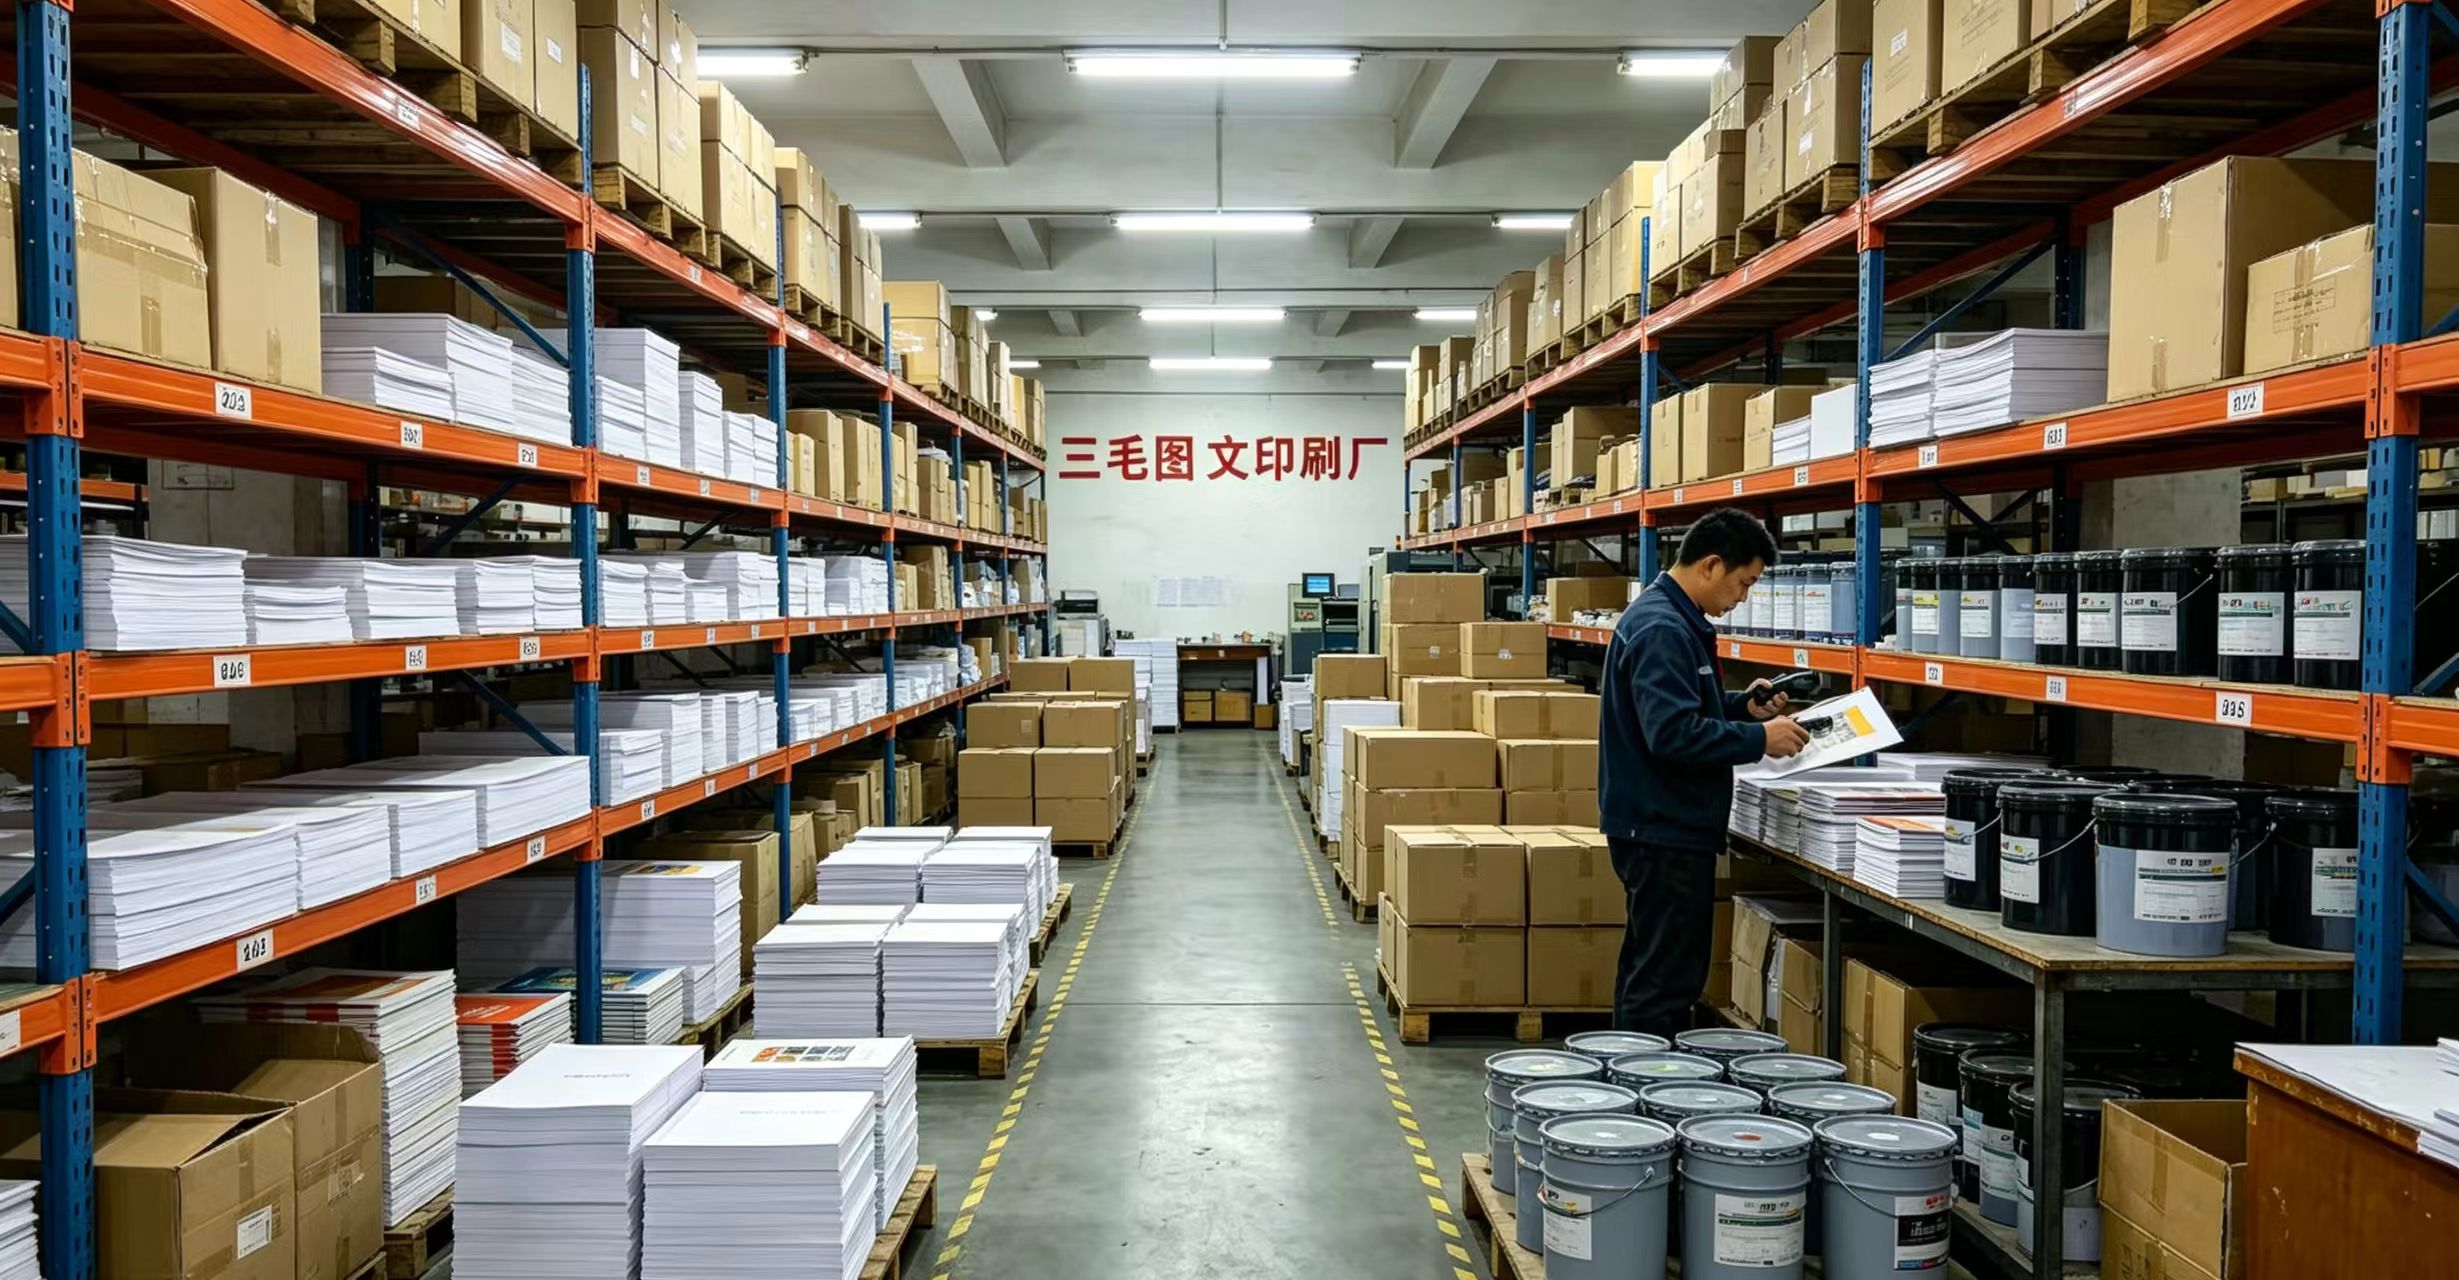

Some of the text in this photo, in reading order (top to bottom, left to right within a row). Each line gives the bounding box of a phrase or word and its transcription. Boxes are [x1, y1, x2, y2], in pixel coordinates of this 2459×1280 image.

[1059, 434, 1388, 481] 三毛图文印刷厂
